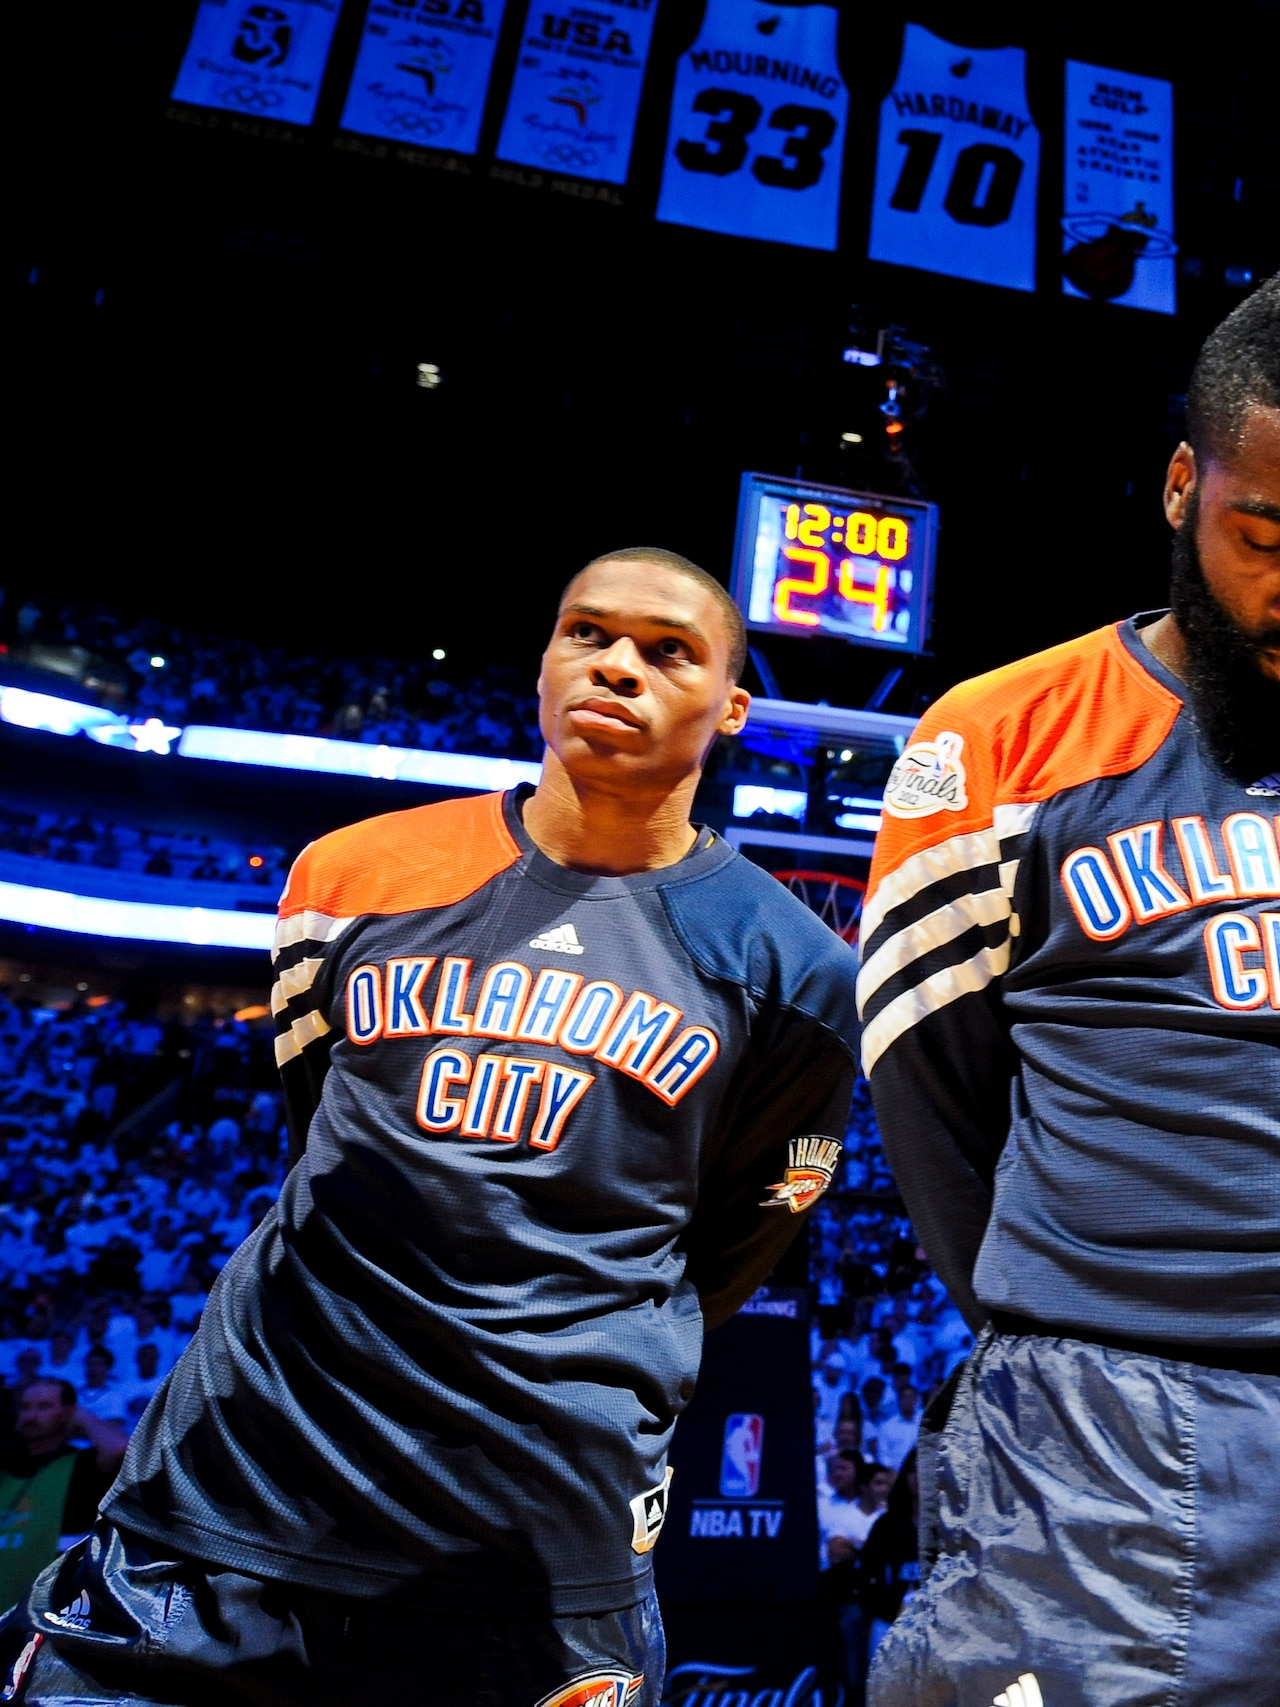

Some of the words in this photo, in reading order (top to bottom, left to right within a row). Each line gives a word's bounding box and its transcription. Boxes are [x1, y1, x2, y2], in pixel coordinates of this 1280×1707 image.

[391, 0, 485, 23] SA
[542, 14, 633, 55] USA
[689, 50, 840, 99] MOURNING
[893, 91, 1030, 142] HARDAWAY
[1090, 95, 1149, 115] CULP
[674, 87, 838, 191] 33
[888, 129, 1025, 228] 10
[784, 504, 908, 560] 12:00
[774, 546, 891, 632] 24
[346, 956, 719, 1107] OKLAHOMA
[415, 1048, 596, 1152] CITY
[689, 1509, 742, 1538] NBA
[749, 1510, 784, 1538] TV
